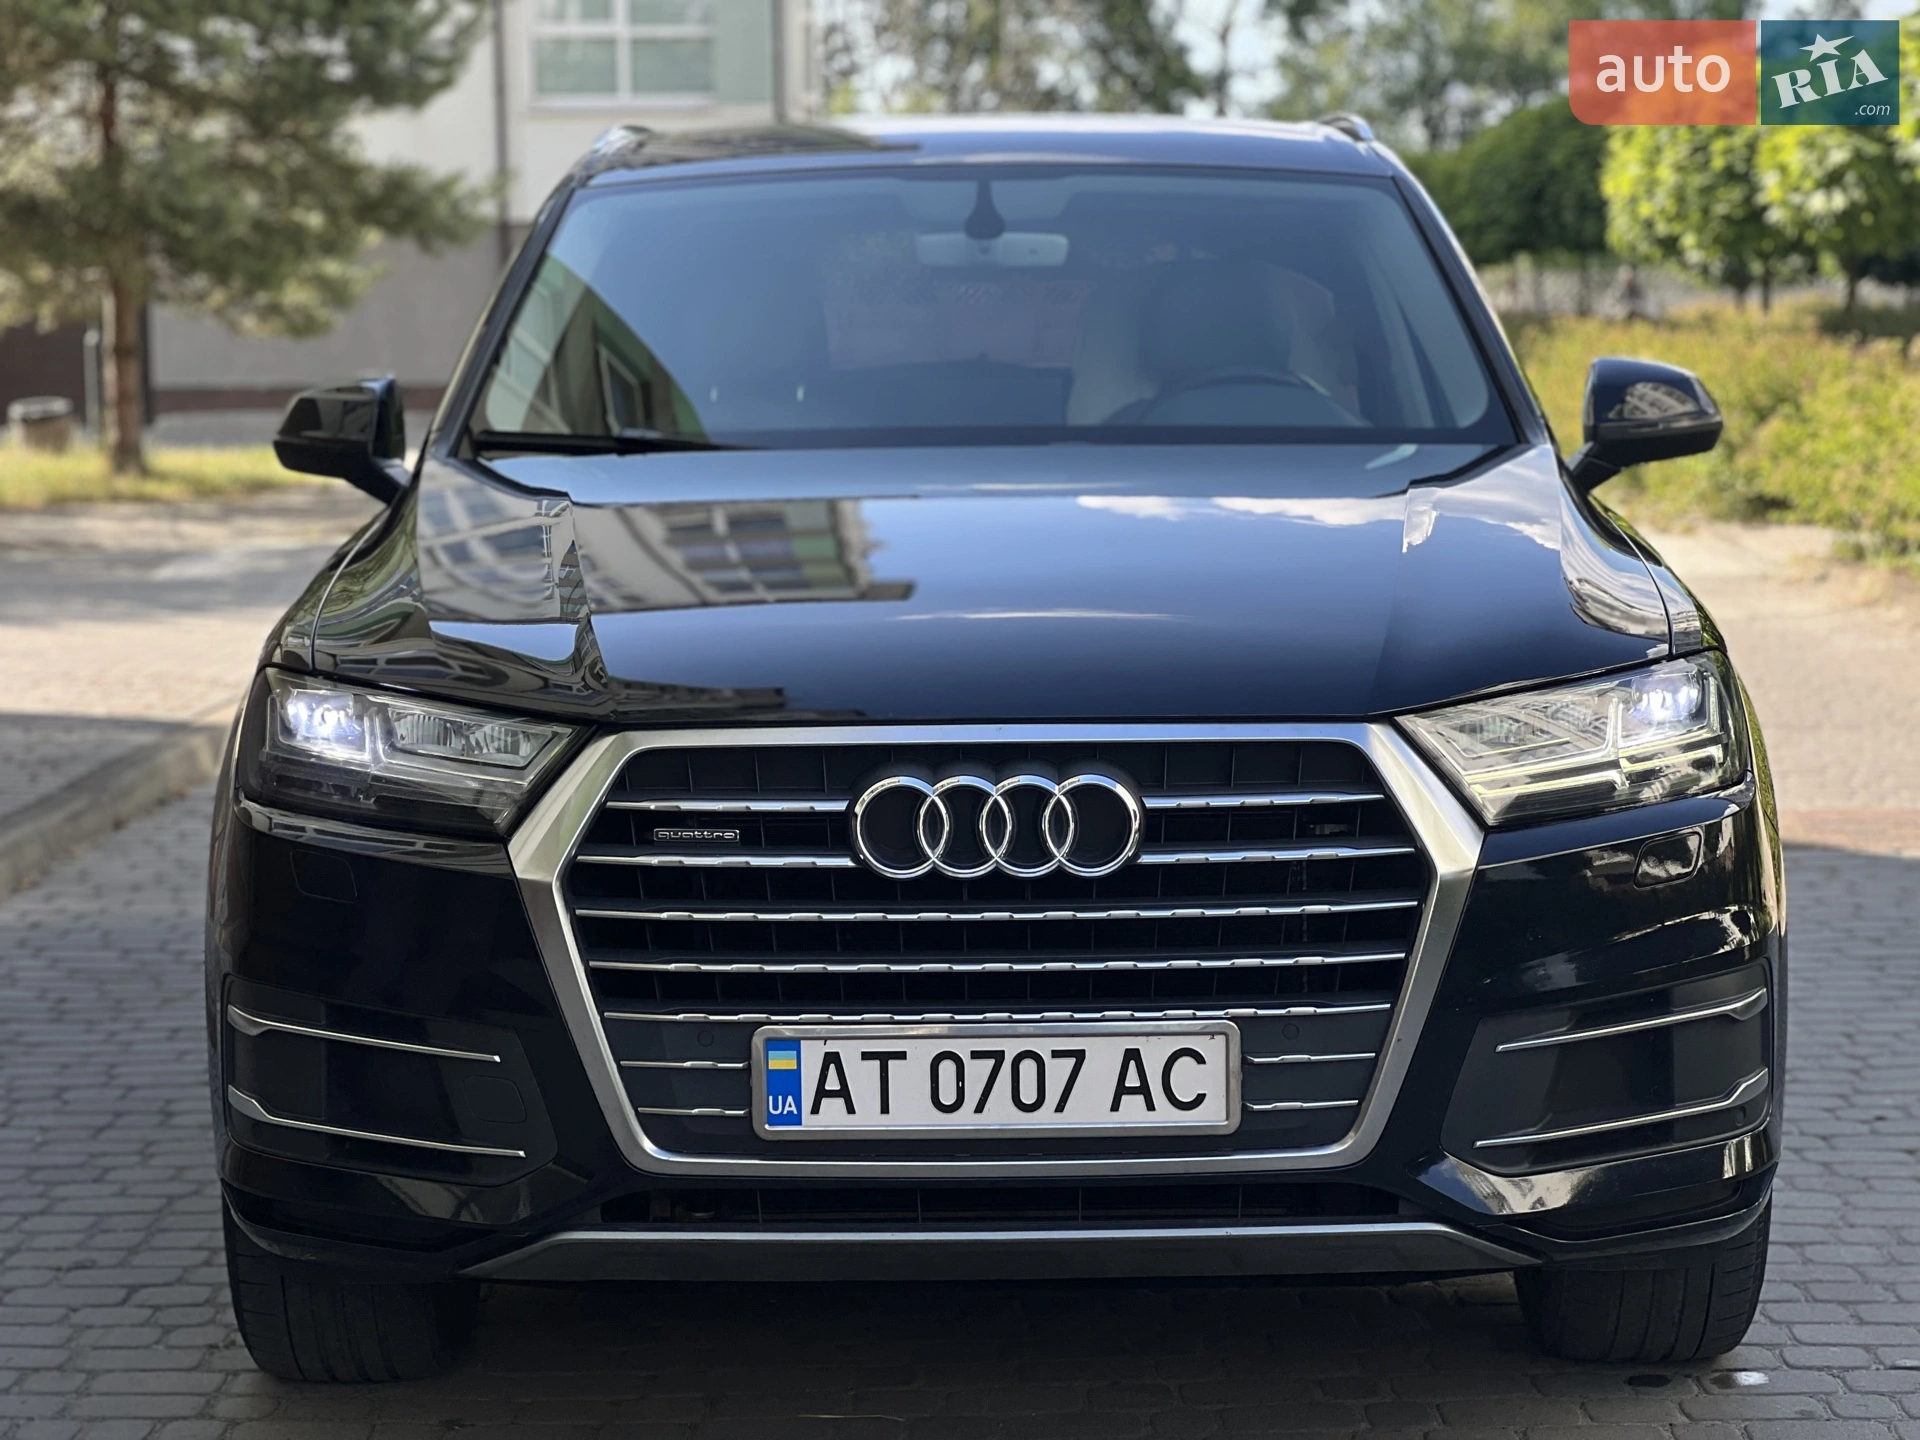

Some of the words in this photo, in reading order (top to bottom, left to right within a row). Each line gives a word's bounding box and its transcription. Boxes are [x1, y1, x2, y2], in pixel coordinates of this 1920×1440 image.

[658, 831, 735, 840] quattro
[810, 1050, 908, 1116] AT
[929, 1048, 1087, 1114] 0707
[1109, 1047, 1208, 1113] AC
[768, 1095, 799, 1116] UA
